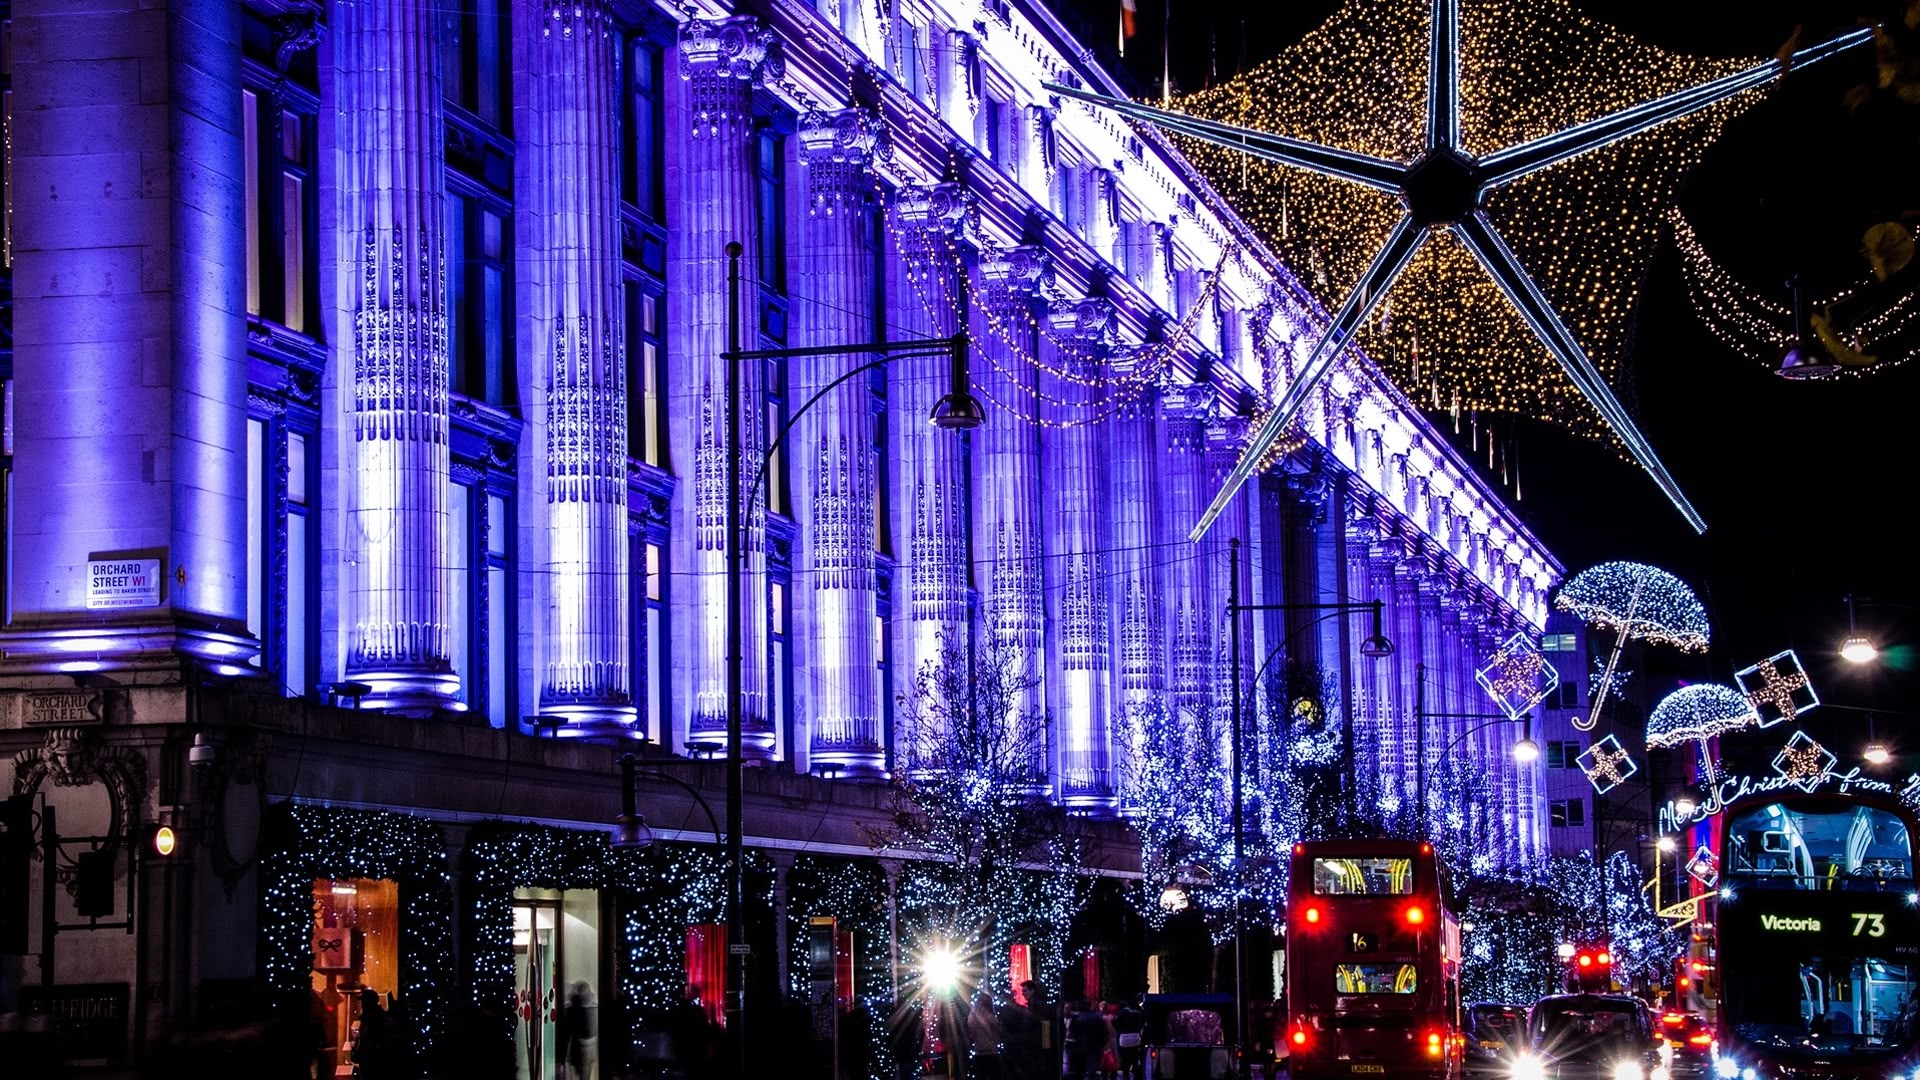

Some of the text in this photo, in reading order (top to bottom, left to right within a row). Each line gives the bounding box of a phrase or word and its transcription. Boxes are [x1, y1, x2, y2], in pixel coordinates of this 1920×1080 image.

[93, 564, 141, 575] ORCHARD
[93, 576, 146, 587] STREET W1
[33, 695, 87, 708] ORCHARD
[33, 708, 85, 720] STREET
[1761, 913, 1885, 937] Victoria 73
